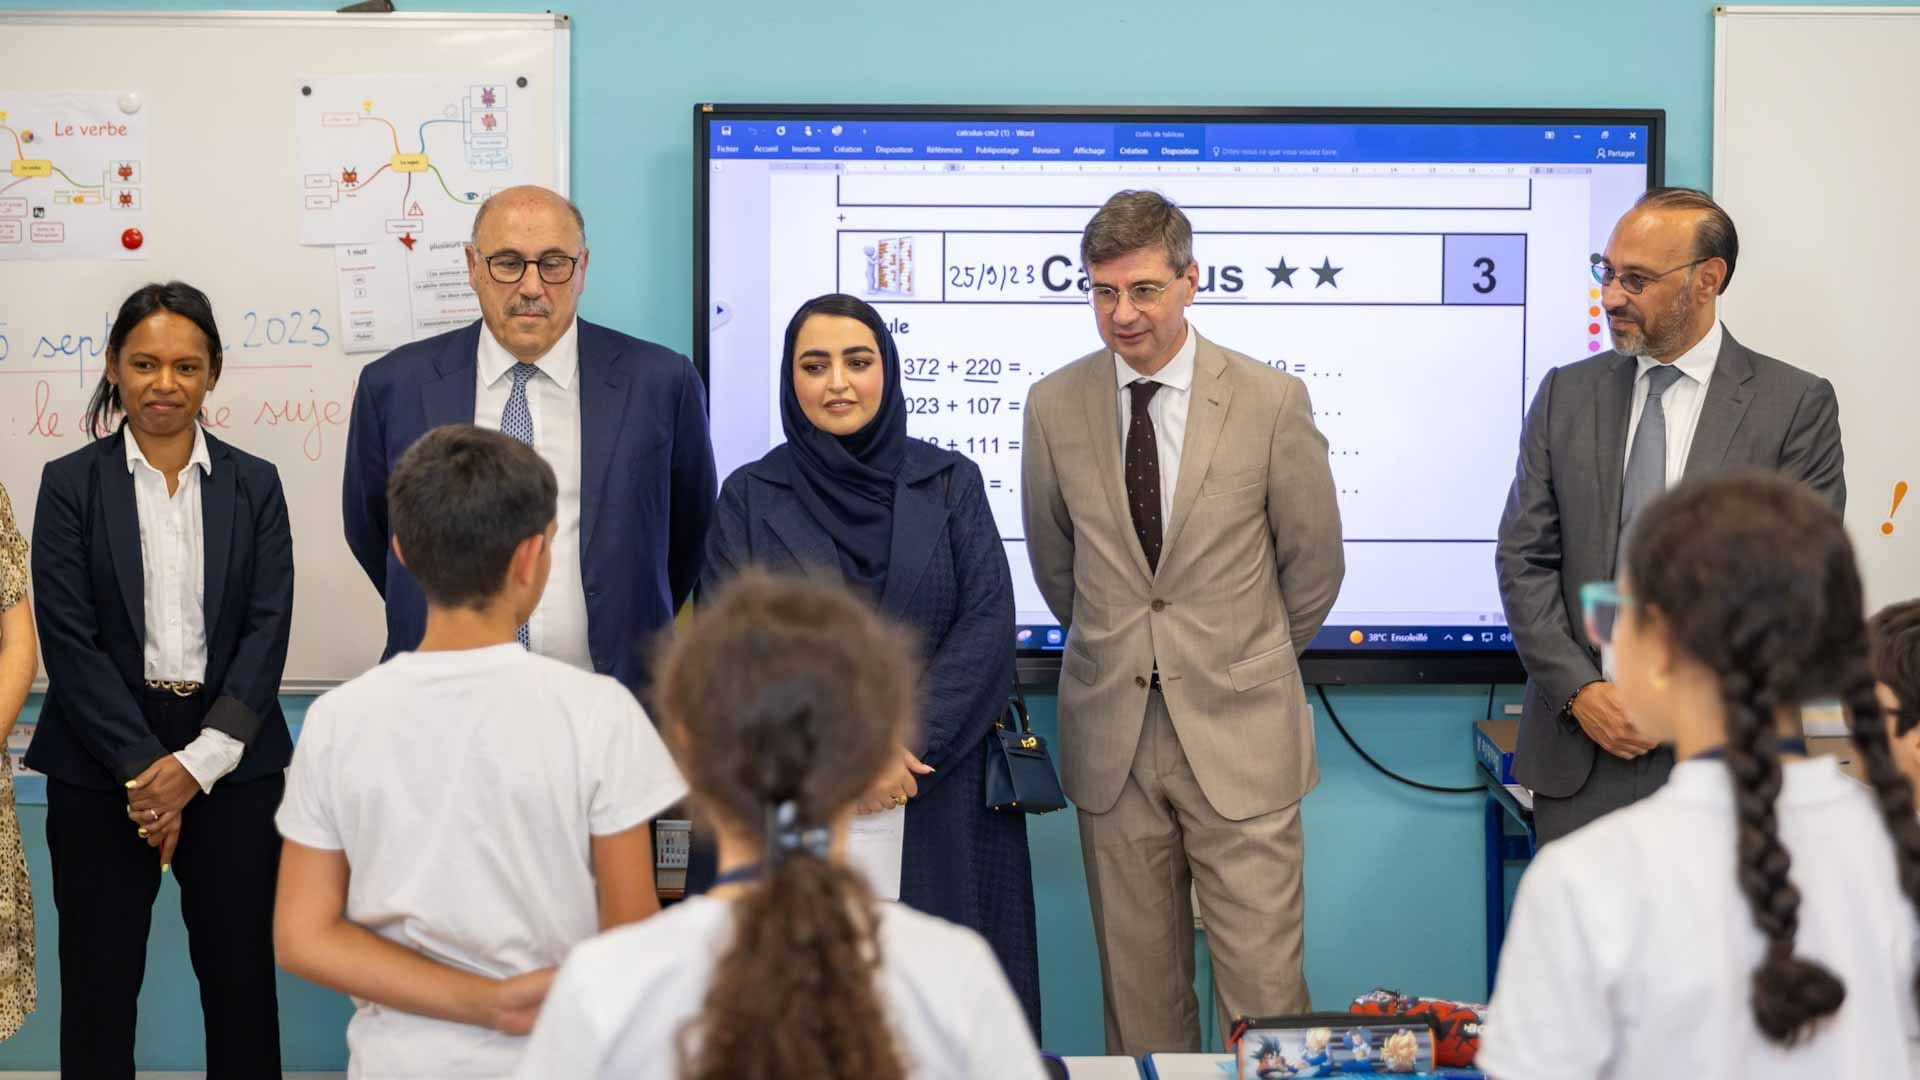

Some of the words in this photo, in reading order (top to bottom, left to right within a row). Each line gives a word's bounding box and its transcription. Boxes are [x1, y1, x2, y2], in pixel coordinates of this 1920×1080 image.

[54, 121, 73, 137] Le
[80, 121, 128, 137] verbe
[1016, 128, 1035, 138] Word
[716, 144, 739, 153] Fichier
[753, 144, 779, 153] Accueil
[791, 145, 821, 153] Insertion
[833, 145, 863, 153] Création
[875, 145, 914, 155] Disposition
[926, 145, 963, 154] Références
[975, 146, 1020, 156] Publipostage
[1032, 146, 1060, 155] Révision
[1073, 146, 1106, 156] Affichage
[1119, 146, 1148, 155] Création
[1161, 147, 1199, 156] Disposition
[1607, 148, 1636, 159] Partager
[1471, 257, 1498, 294] 3
[243, 308, 331, 349] 2023
[966, 358, 1002, 376] 220
[28, 379, 64, 437] le
[967, 397, 1002, 415] 107
[966, 437, 1000, 454] 111
[1367, 632, 1388, 642] 38°C
[1391, 632, 1429, 642] Ensoleillé
